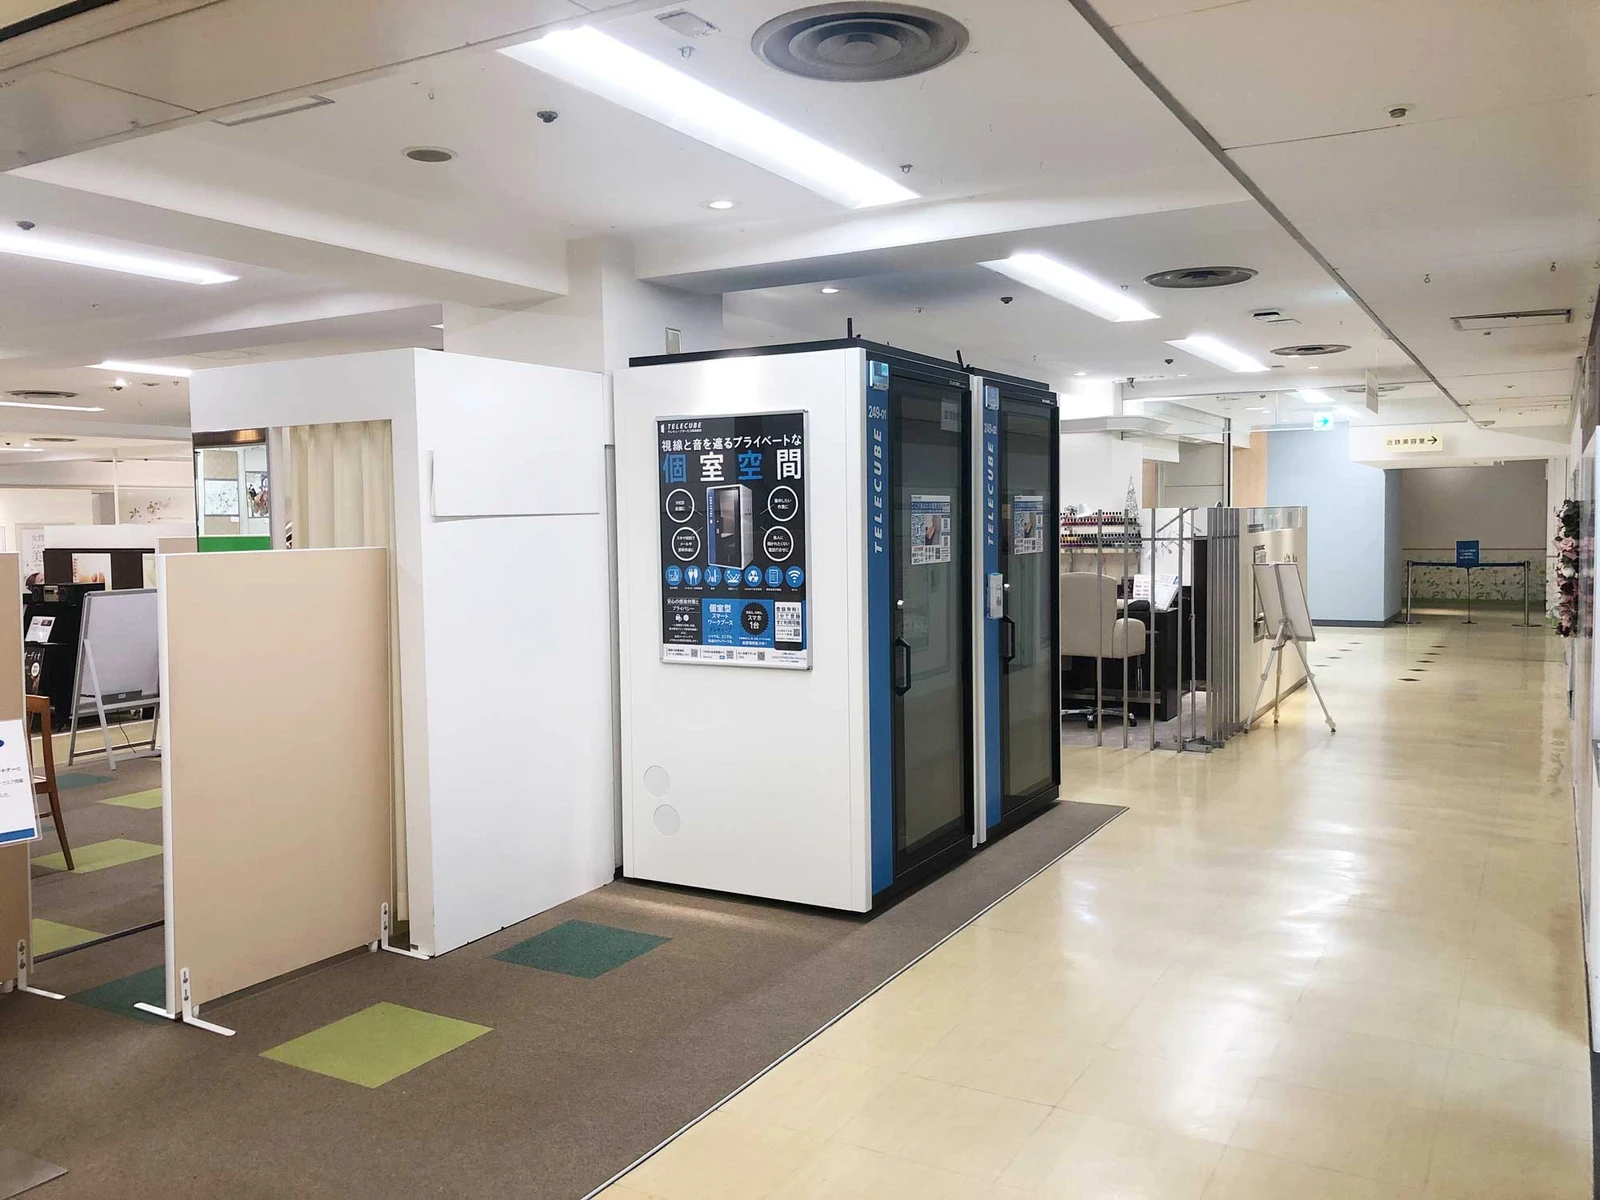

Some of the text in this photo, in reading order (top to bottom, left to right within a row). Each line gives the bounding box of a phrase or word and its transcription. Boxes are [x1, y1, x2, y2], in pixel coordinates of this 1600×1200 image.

[667, 421, 702, 429] TELECUBE
[868, 405, 887, 420] 249-01
[661, 433, 802, 452] 視線と音を遮るプライベートな
[662, 448, 802, 484] 個室空間
[873, 428, 883, 554] TELECUBE
[987, 442, 995, 547] TELECUBE
